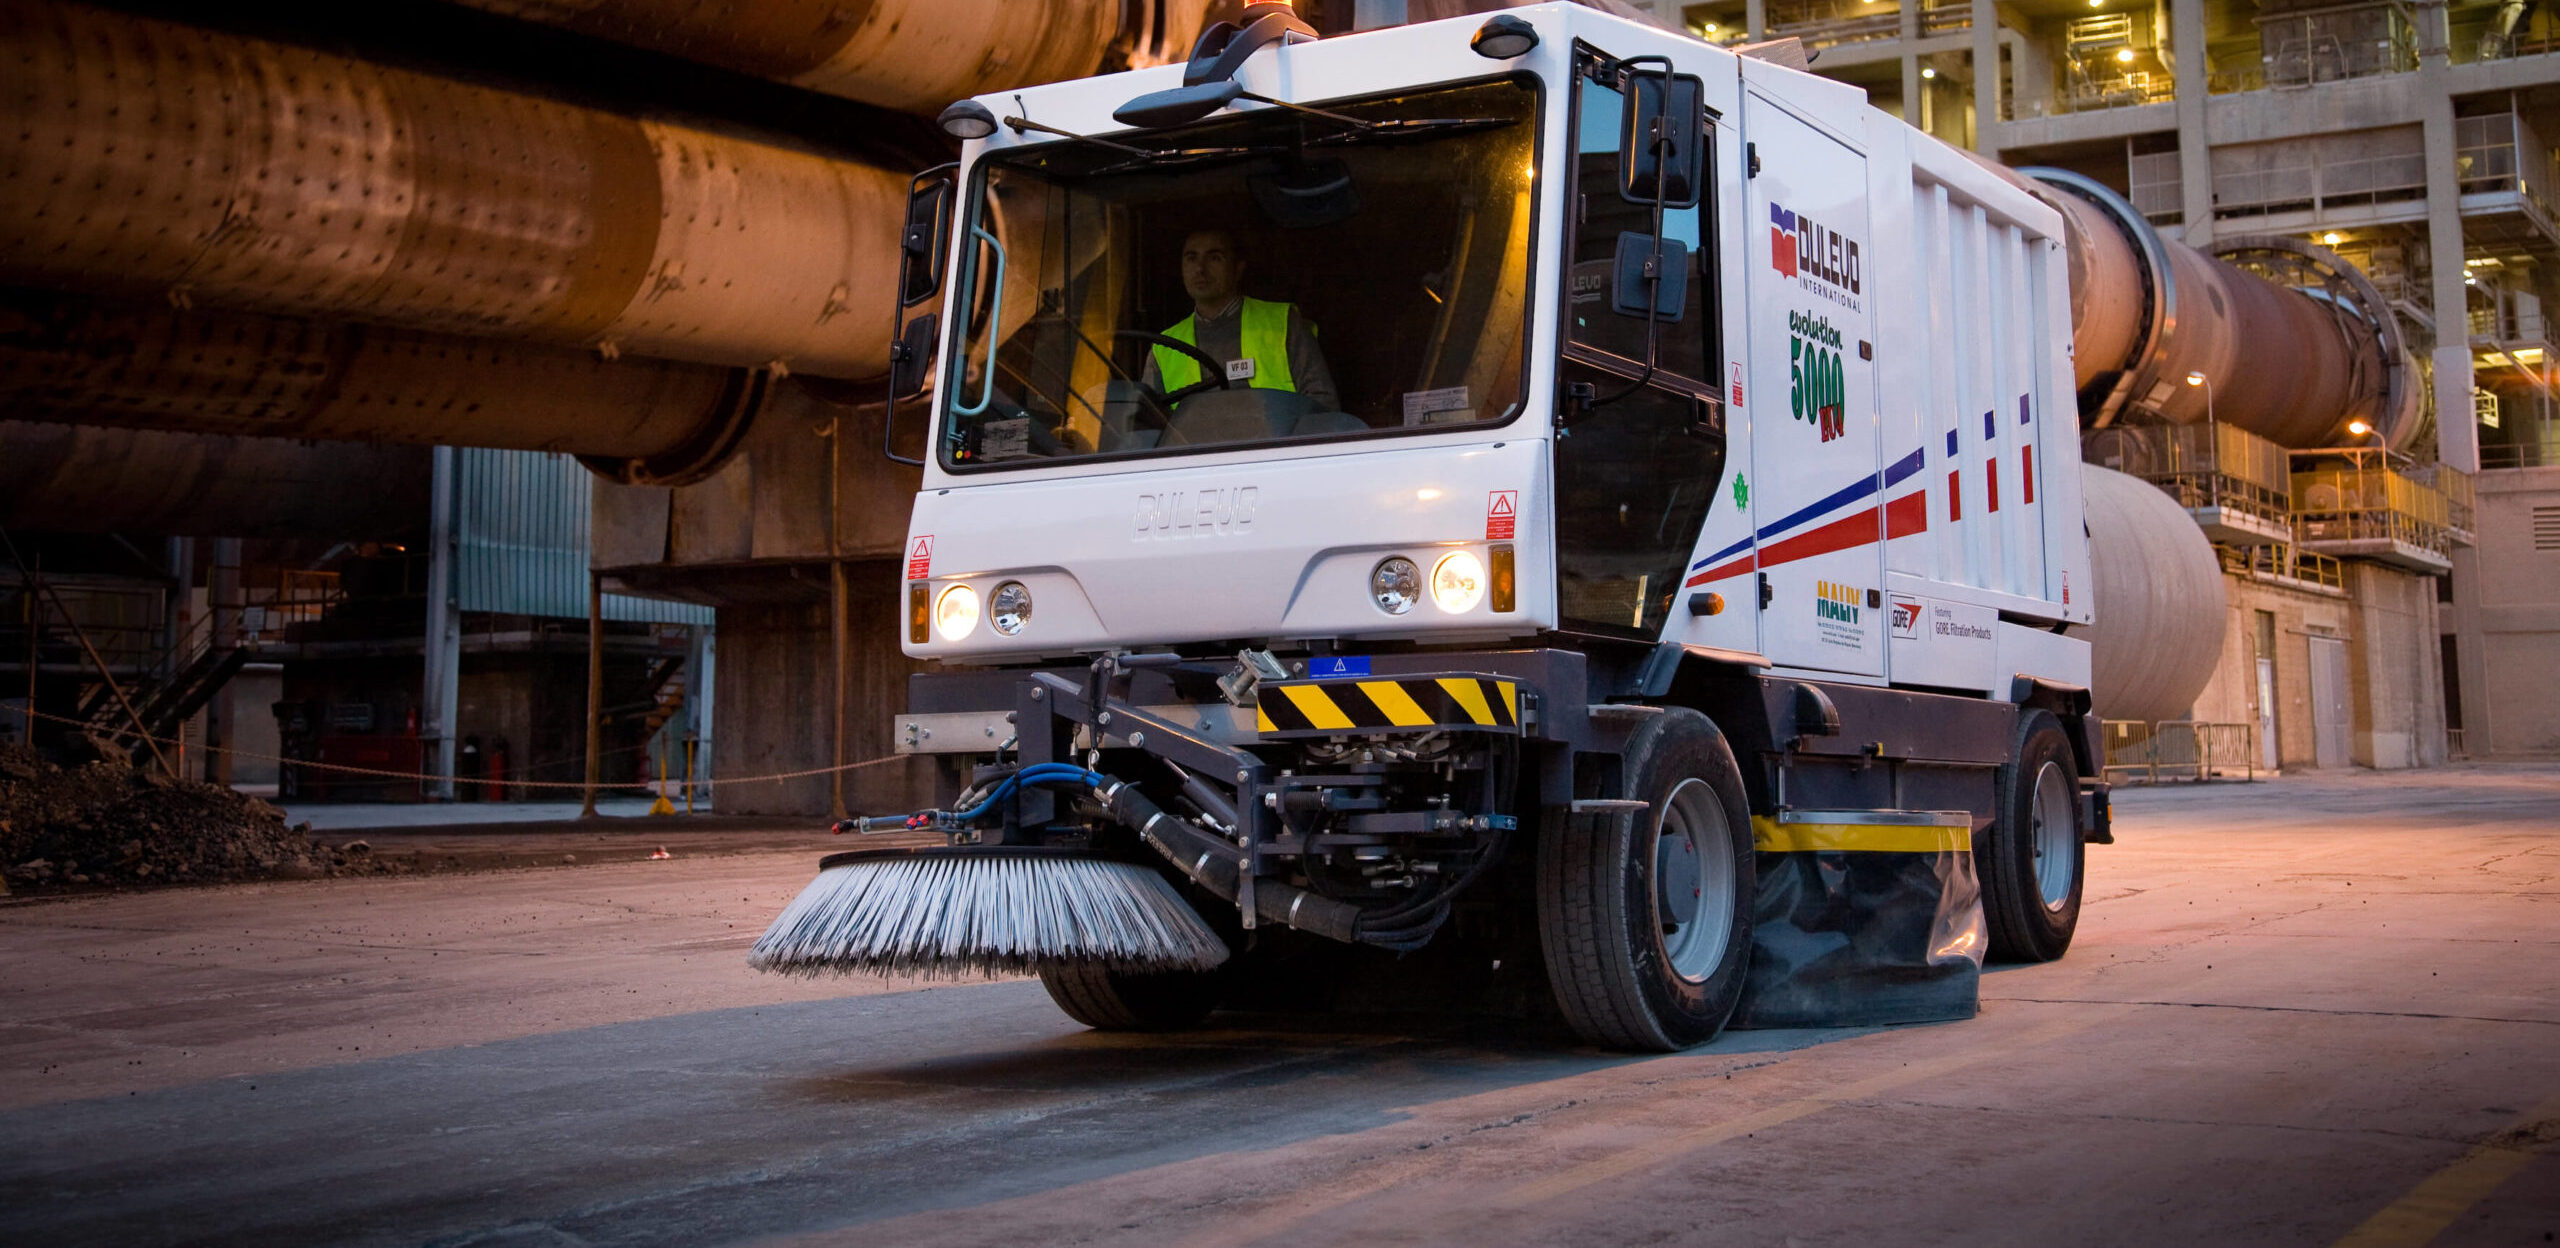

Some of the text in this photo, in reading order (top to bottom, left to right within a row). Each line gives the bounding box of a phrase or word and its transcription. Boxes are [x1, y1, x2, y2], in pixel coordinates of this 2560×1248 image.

[1798, 215, 1860, 296] DULEVO
[1799, 276, 1861, 314] INTERNATIONAL
[1789, 309, 1843, 351] evolution
[1791, 334, 1845, 425] 5000
[1133, 486, 1258, 541] DULEVO
[1893, 609, 1908, 628] GORE
[1935, 606, 1951, 620] Featuring
[1951, 623, 1971, 638] Filtration
[1971, 625, 1991, 640] Products
